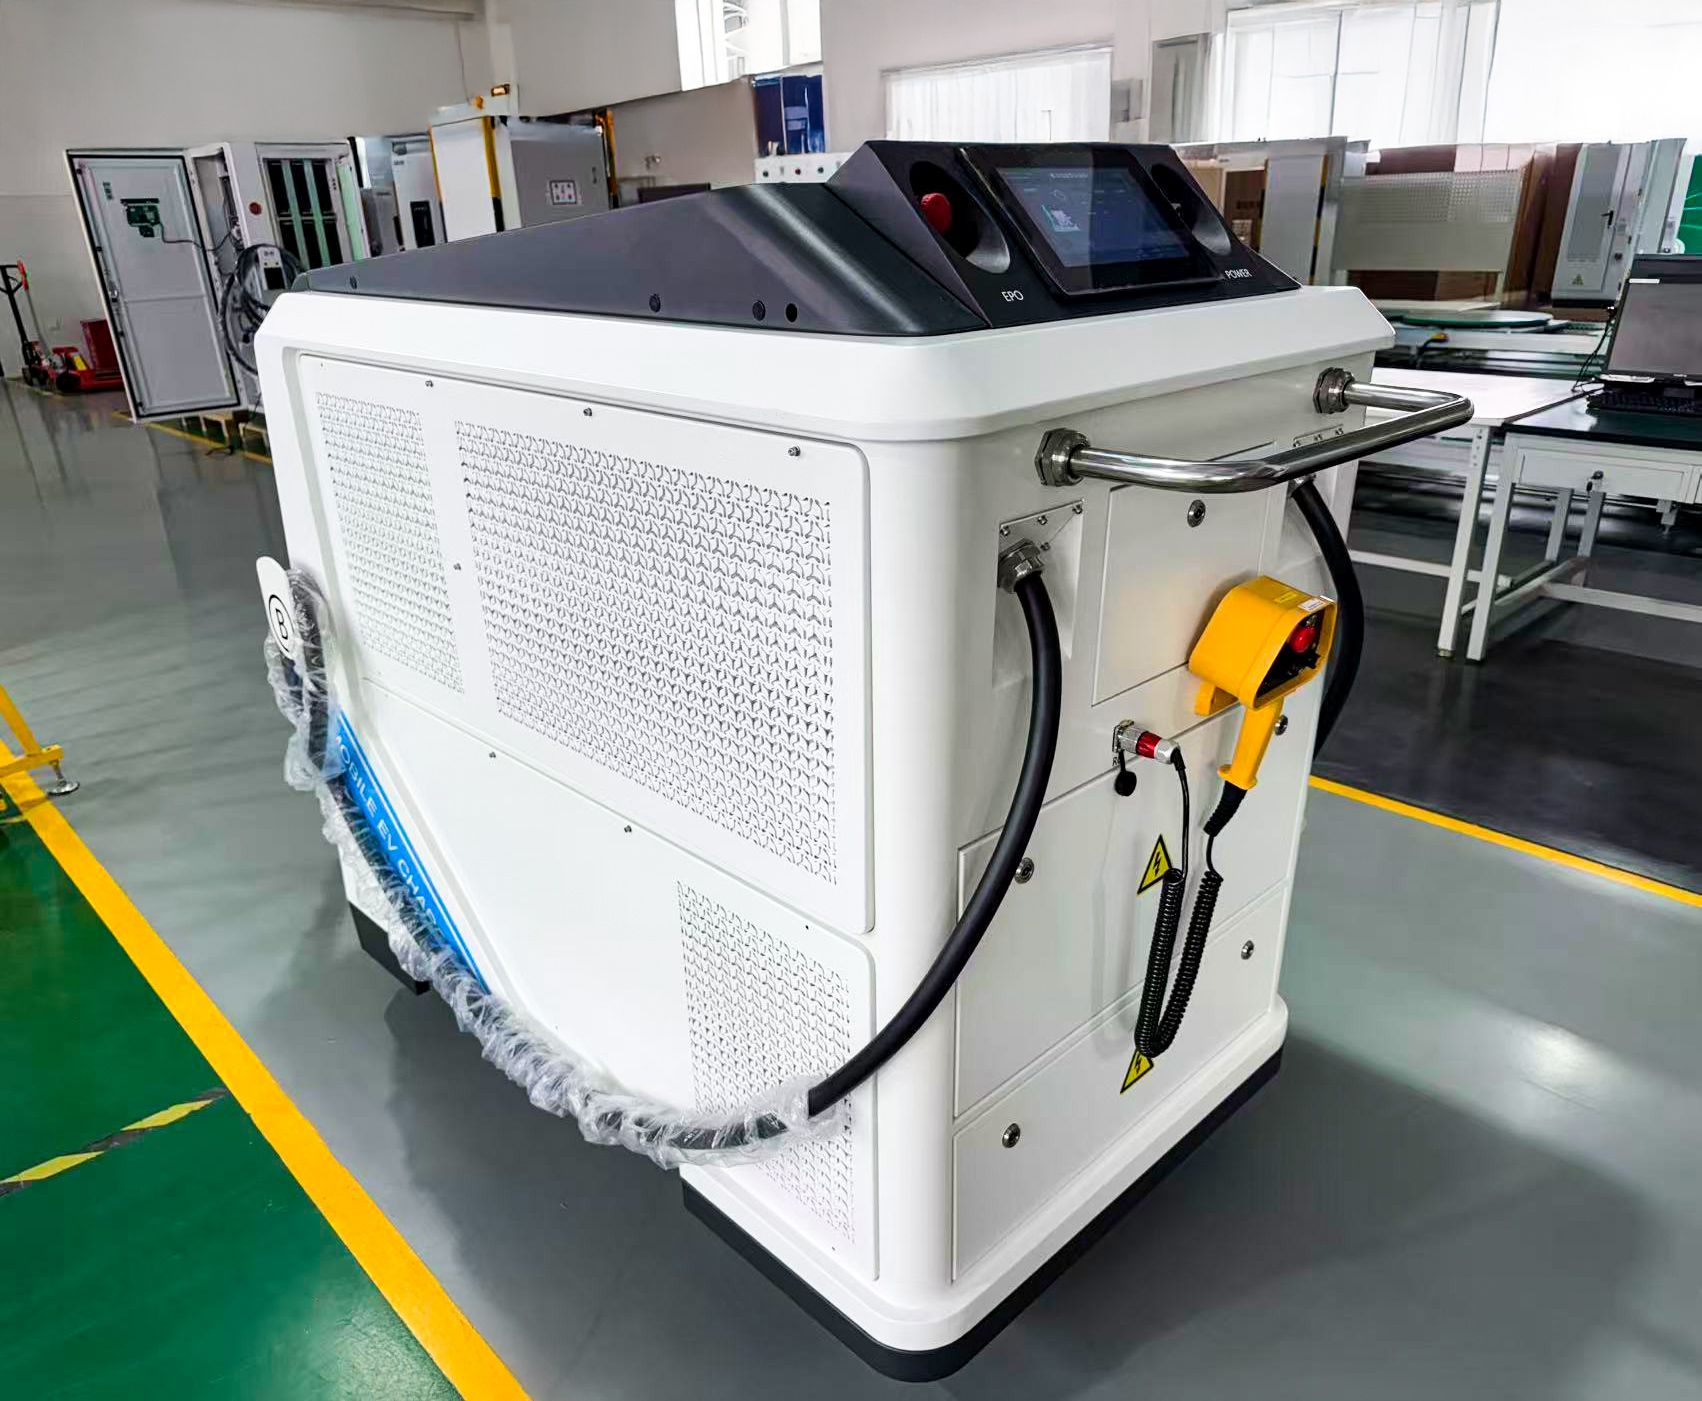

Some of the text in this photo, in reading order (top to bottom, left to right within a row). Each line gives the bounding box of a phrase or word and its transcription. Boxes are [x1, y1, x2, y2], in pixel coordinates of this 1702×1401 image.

[1224, 268, 1253, 279] POWER
[1001, 290, 1024, 302] EPO
[376, 818, 399, 851] EV
